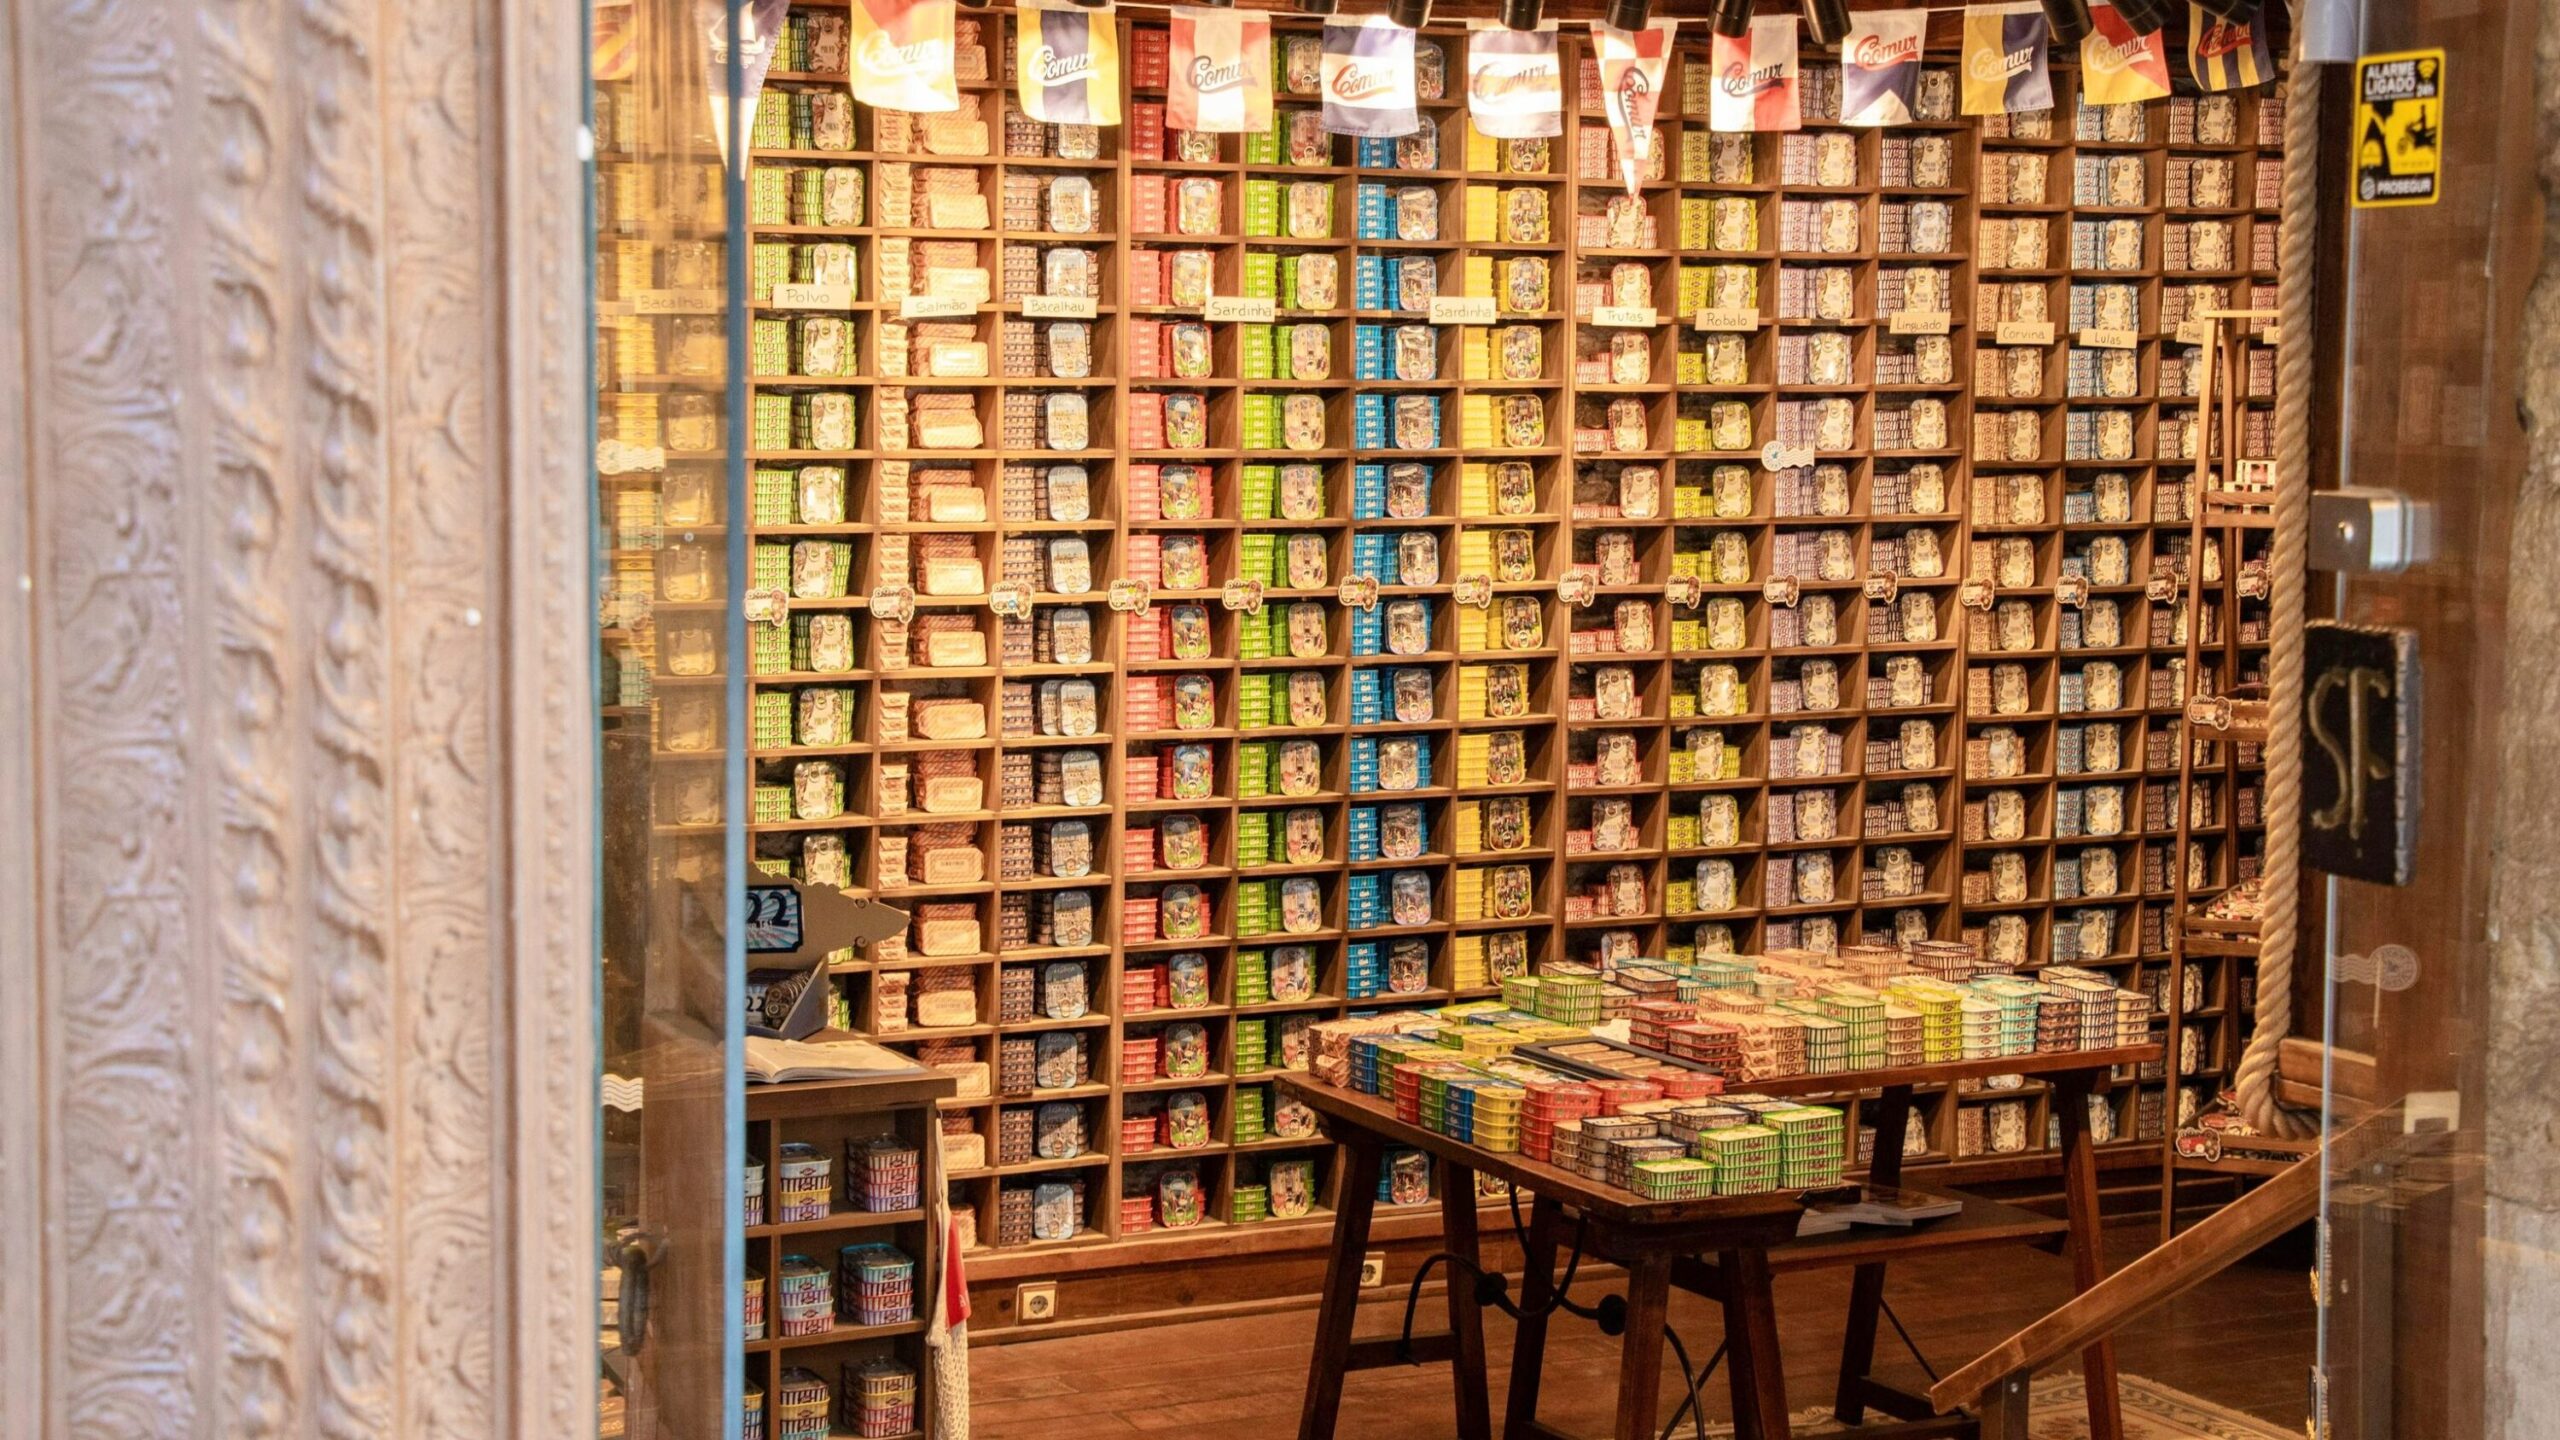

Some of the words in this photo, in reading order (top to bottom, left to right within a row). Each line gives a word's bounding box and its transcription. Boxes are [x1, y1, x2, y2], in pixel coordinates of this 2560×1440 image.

[1854, 33, 1920, 73] Comur
[2087, 34, 2154, 74] Comur
[1029, 45, 1096, 86] Comur
[1969, 44, 2034, 82] Comur
[2367, 62, 2416, 77] ALARME
[1186, 55, 1257, 94] Comur
[1331, 62, 1396, 101] Comur
[1720, 60, 1786, 98] Comur
[2365, 77, 2415, 94] LIGADO
[1618, 66, 1648, 142] Comur
[2377, 178, 2431, 195] PROSEGUR
[640, 294, 714, 312] Bacalhau
[786, 287, 831, 305] Polvo
[915, 299, 968, 314] Salmão
[1031, 300, 1085, 313] Bacalhau
[1212, 301, 1272, 317] Sardinha
[1434, 304, 1492, 319] Sardinha
[1606, 310, 1644, 323] Trutas
[1706, 313, 1748, 327] Robalo
[1896, 318, 1942, 332] Linguado
[2003, 327, 2045, 340] Corvina
[2094, 333, 2122, 345] Lulas
